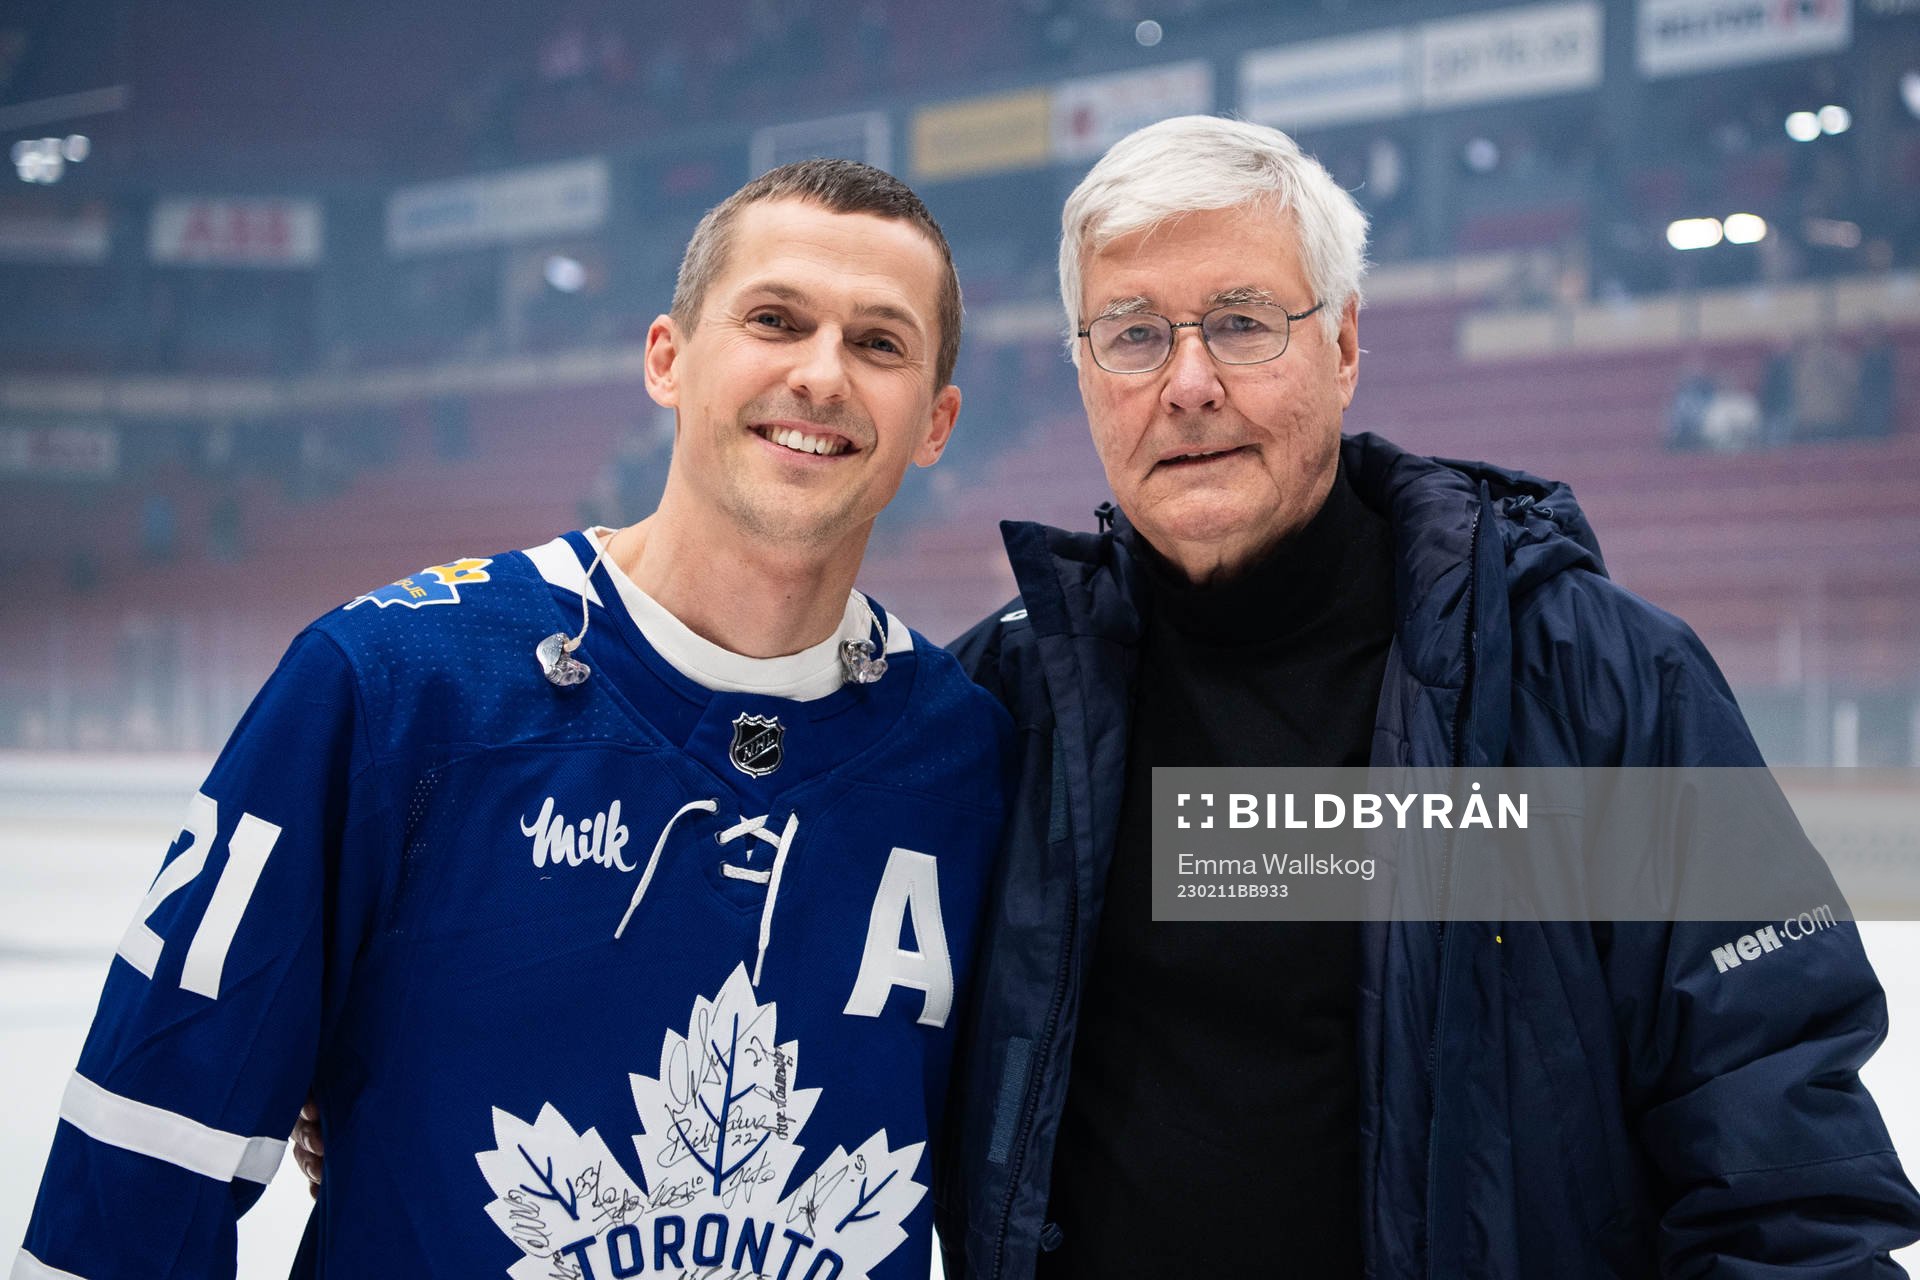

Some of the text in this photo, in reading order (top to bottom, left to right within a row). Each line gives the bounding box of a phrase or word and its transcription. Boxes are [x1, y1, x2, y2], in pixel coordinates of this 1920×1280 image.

[116, 790, 283, 1000] 21
[520, 796, 637, 873] Milk
[843, 847, 954, 1029] A
[560, 1213, 844, 1280] TORONTO
